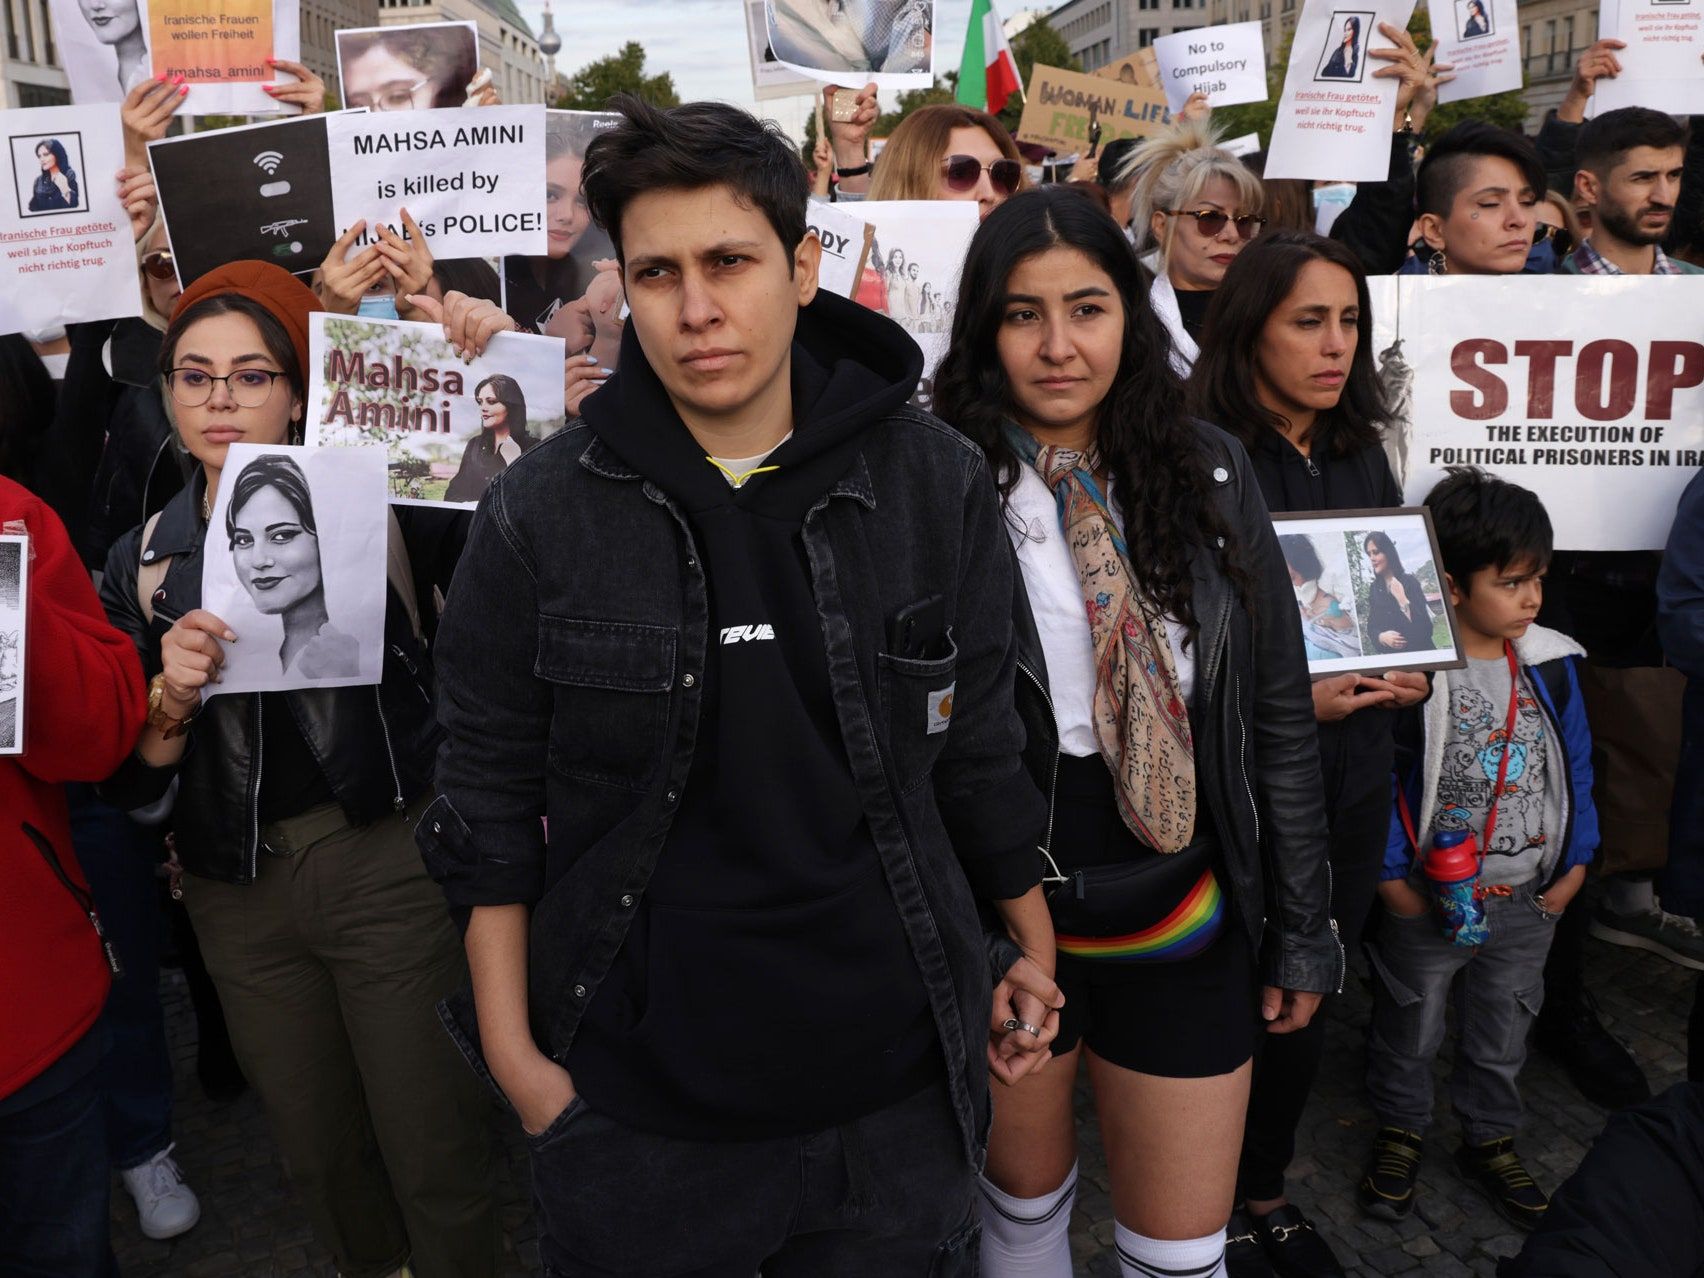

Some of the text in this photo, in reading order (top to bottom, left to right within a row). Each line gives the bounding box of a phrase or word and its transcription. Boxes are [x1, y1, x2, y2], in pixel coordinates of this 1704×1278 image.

[164, 14, 259, 25] Iranische Frauen
[171, 29, 255, 41] wollen Freiheit
[1188, 40, 1225, 56] No to
[1172, 58, 1247, 79] Compulsory
[1193, 80, 1227, 96] Hijab
[1327, 91, 1345, 101] Frau
[1039, 81, 1116, 117] WOMAN
[1295, 107, 1376, 119] weil sie ihr Kopftuch
[1297, 121, 1315, 130] nicht
[1316, 121, 1343, 133] richtig
[353, 124, 524, 155] MAHSA AMINI
[377, 171, 499, 199] is killed by
[50, 225, 73, 237] Frau
[75, 221, 117, 236] getötet,
[444, 212, 542, 235] POLICE!
[7, 238, 113, 259] weil sie ihr Kopftuch
[18, 256, 107, 274] nicht richtig trug.
[329, 349, 464, 396] Mahsa
[1449, 338, 1704, 421] STOP
[324, 389, 452, 434] Amini
[1485, 425, 1665, 443] THE EXECUTION OF
[1430, 447, 1527, 465] POLITICAL
[1532, 448, 1644, 466] PRISONERS
[1649, 449, 1670, 467] IN
